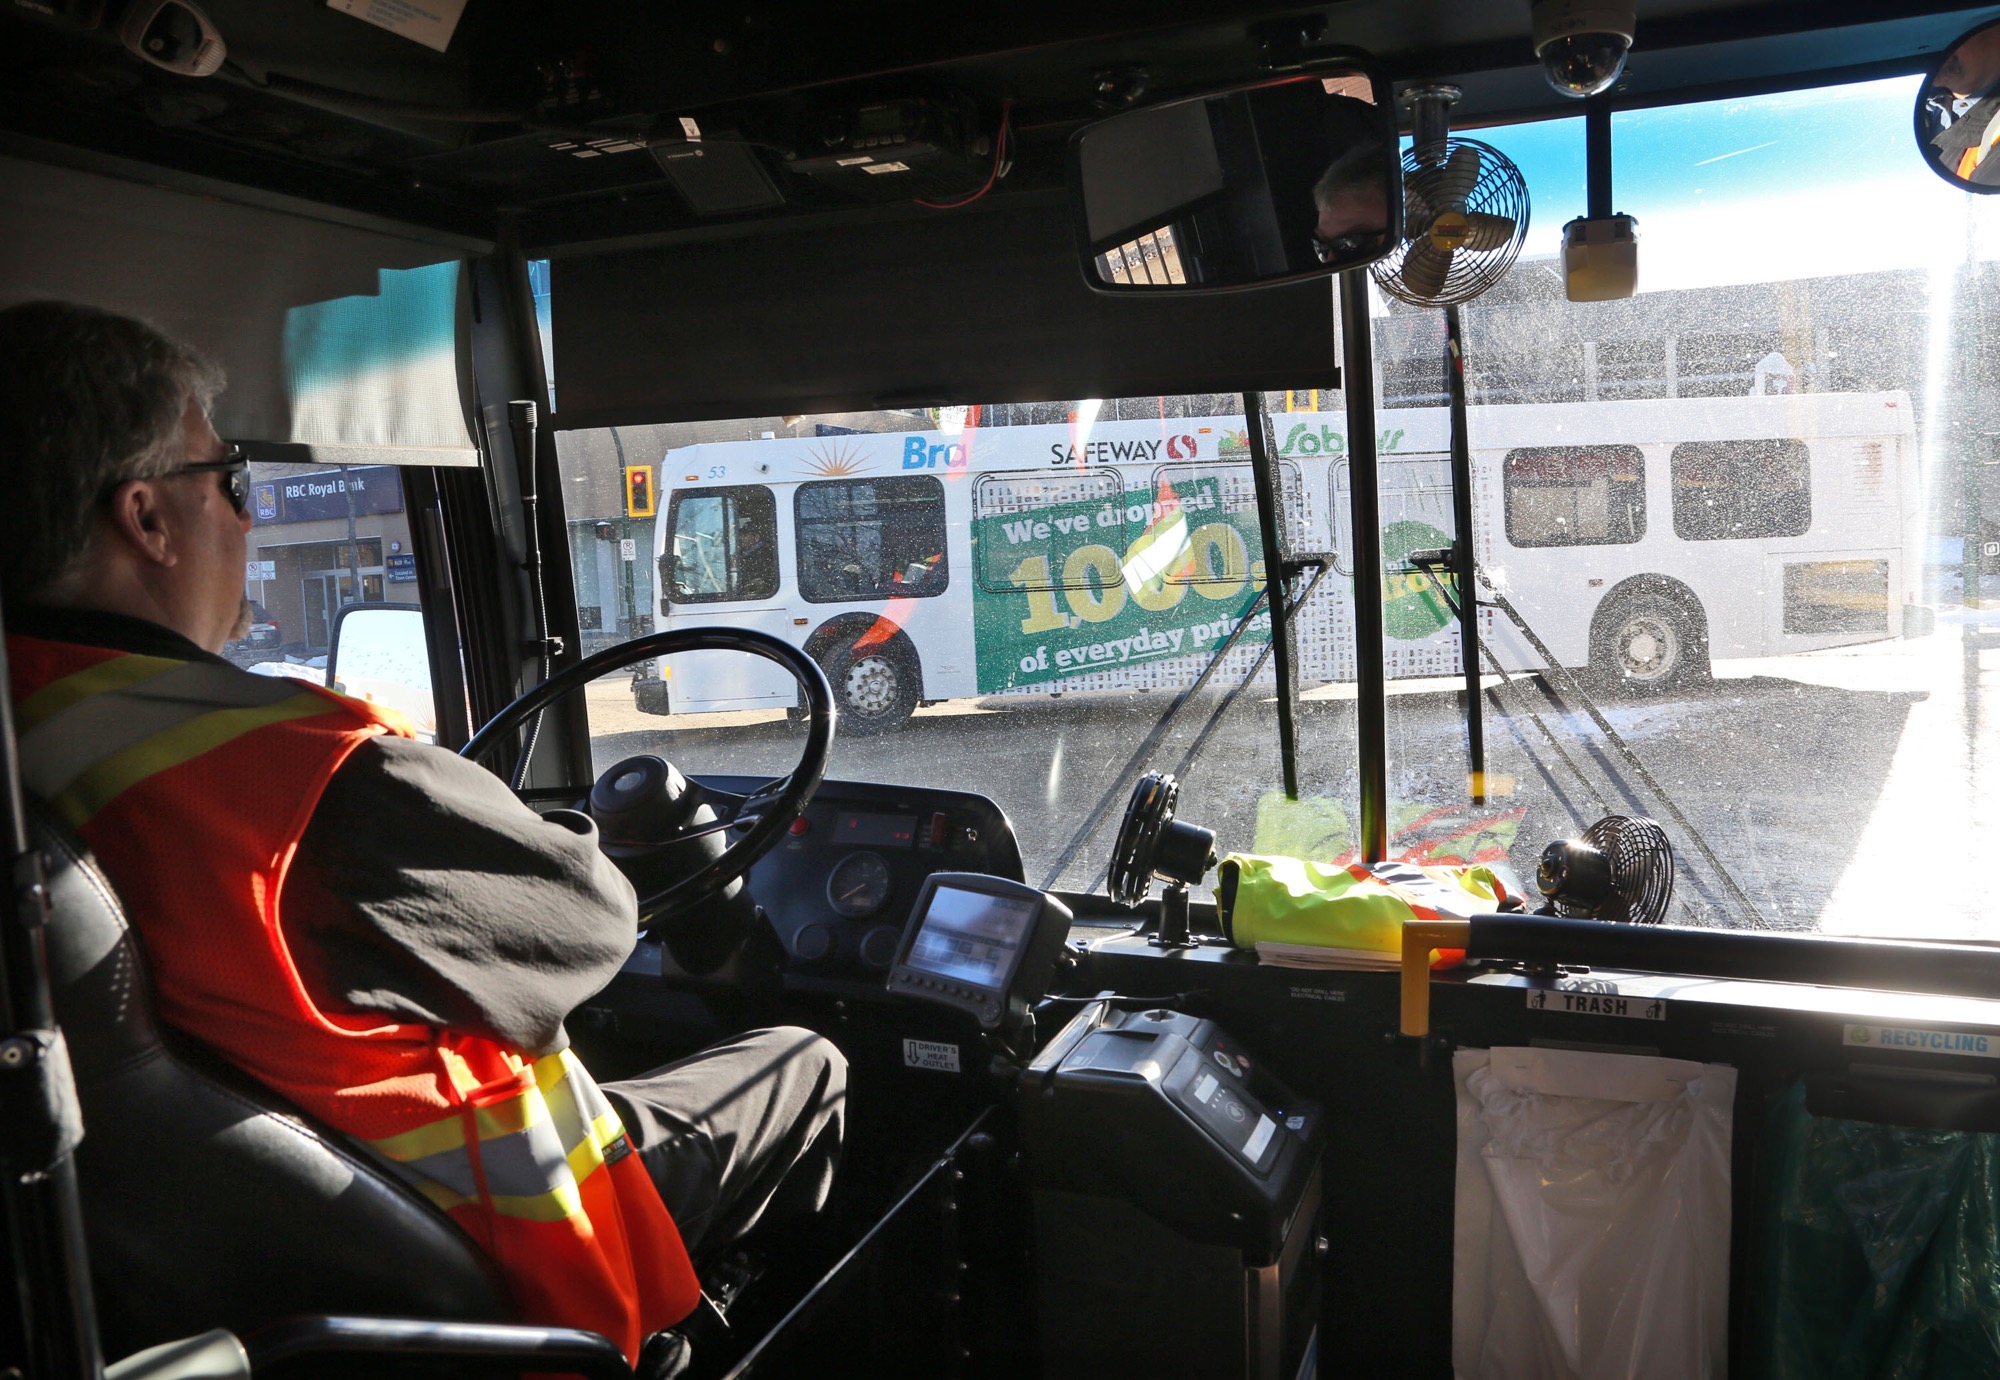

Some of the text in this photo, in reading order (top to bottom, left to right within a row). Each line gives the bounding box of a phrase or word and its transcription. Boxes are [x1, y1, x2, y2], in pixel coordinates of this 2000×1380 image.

[1277, 422, 1405, 455] Sobys
[1051, 440, 1162, 465] SAFEWAY
[707, 465, 726, 479] 53
[286, 478, 365, 498] RBC Royal Bnk
[259, 508, 275, 517] RBC
[1003, 484, 1217, 545] We've dropped
[1020, 645, 1051, 673] of
[1055, 627, 1185, 664] everyday
[1563, 994, 1628, 1015] TRASH
[918, 1042, 957, 1055] DRIVER'S
[1879, 1028, 1988, 1053] RECYCLING
[922, 1059, 955, 1070] OUTLET
[927, 1052, 948, 1062] HEAT
